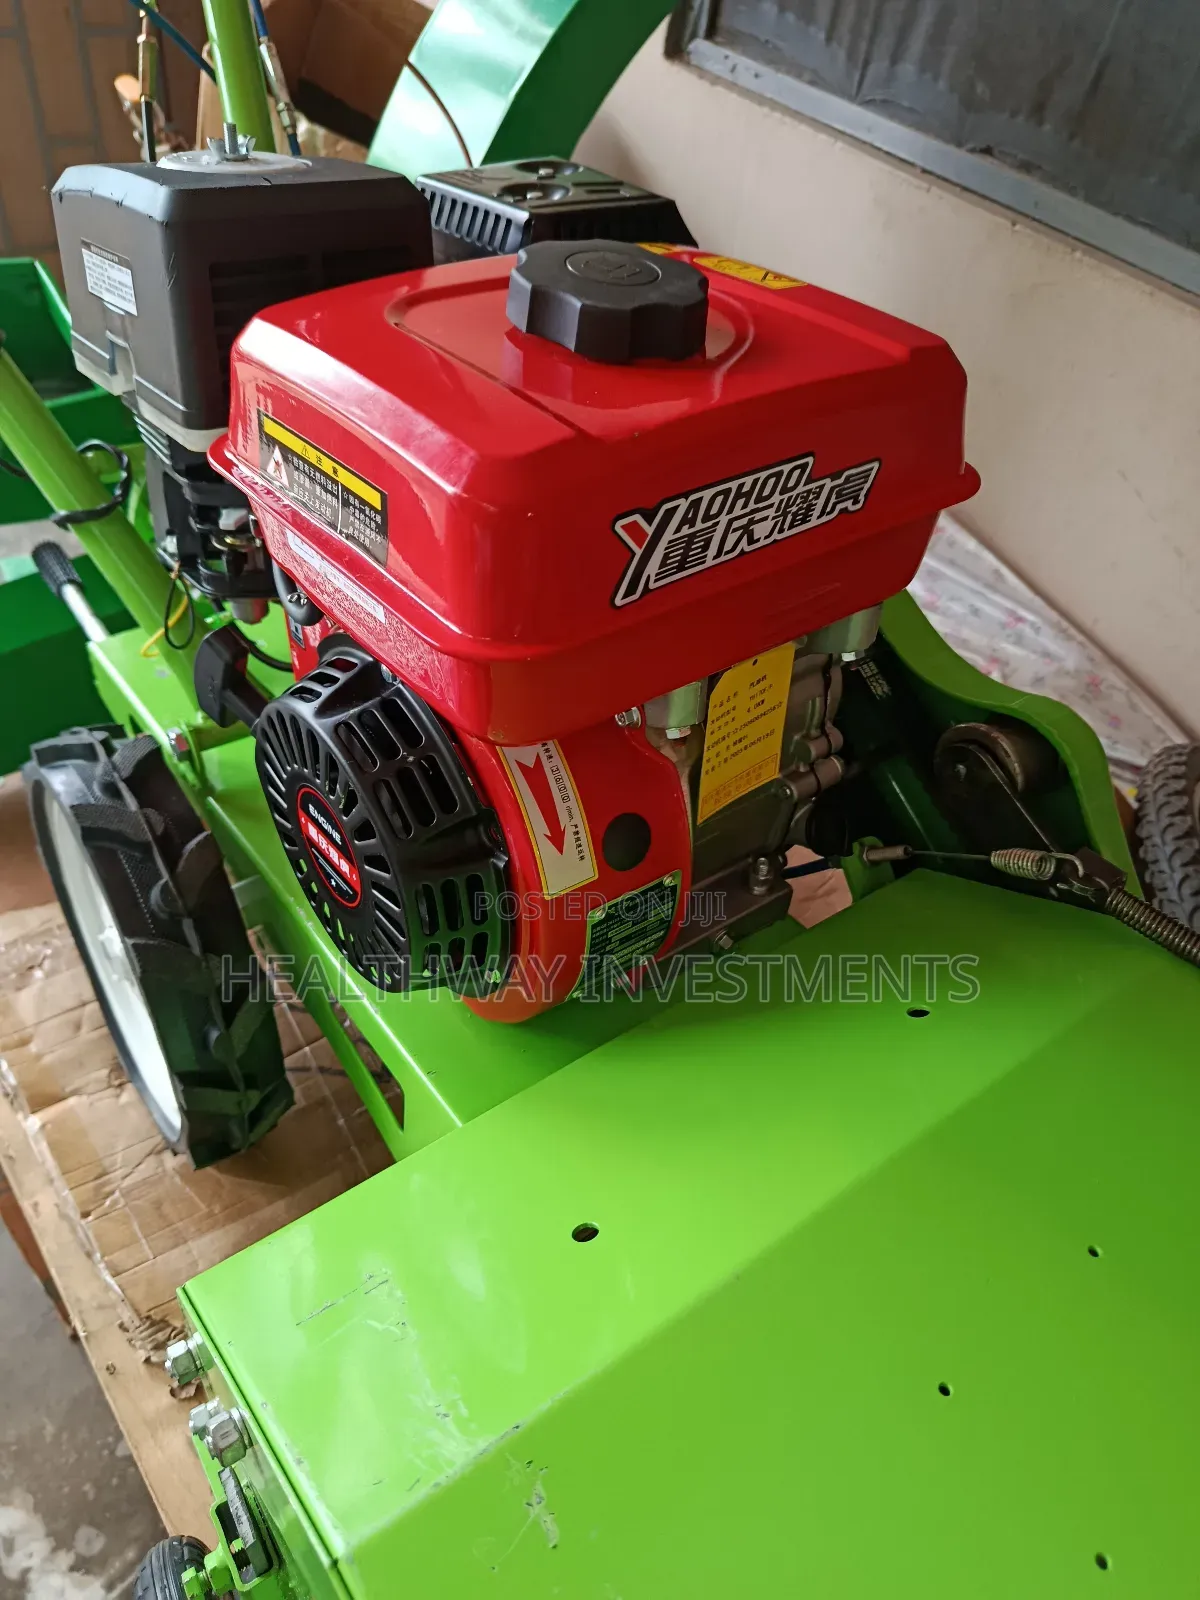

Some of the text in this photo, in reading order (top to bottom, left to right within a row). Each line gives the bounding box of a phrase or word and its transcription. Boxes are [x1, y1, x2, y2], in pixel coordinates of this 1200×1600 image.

[315, 454, 339, 478] 注意
[617, 461, 811, 602] YAOHOO
[652, 464, 876, 584] 重庆耀虎
[550, 764, 571, 804] 3600
[308, 803, 342, 846] ENGINE
